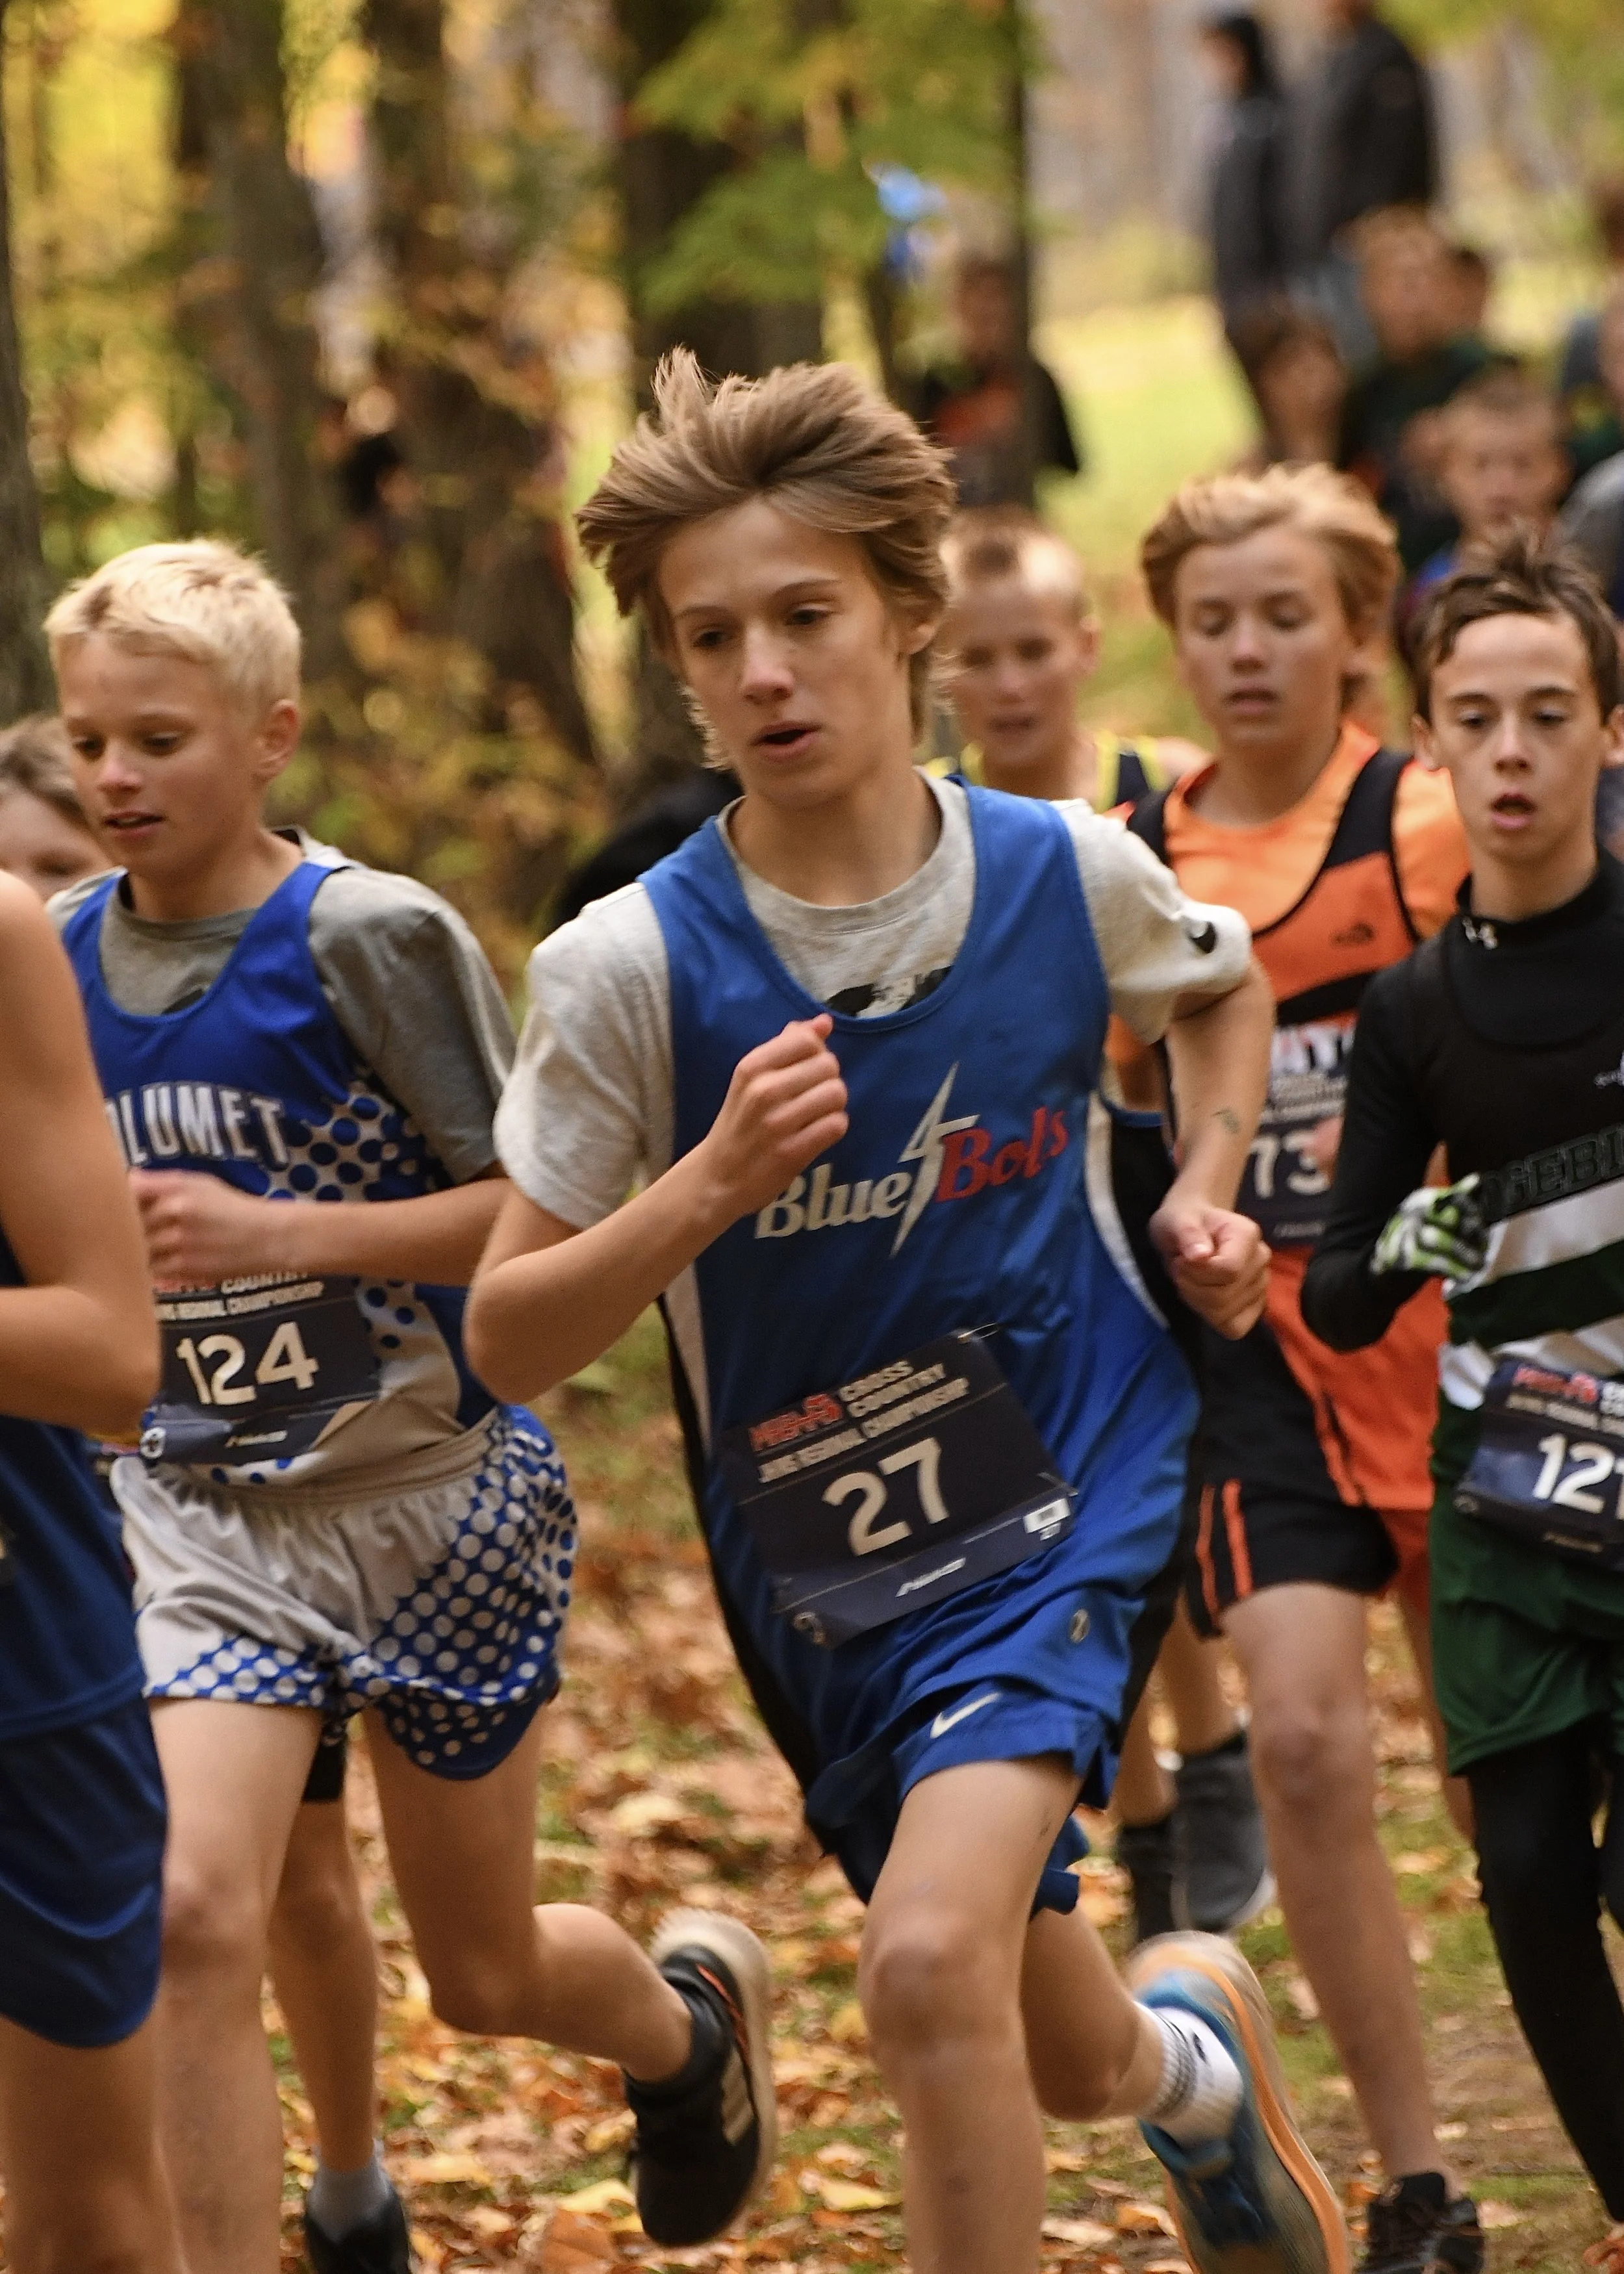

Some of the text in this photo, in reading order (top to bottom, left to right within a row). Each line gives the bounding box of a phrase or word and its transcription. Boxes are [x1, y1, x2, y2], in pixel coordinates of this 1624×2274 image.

[755, 1163, 910, 1238] Blue
[177, 1322, 318, 1405] 124
[822, 1437, 950, 1556] 27
